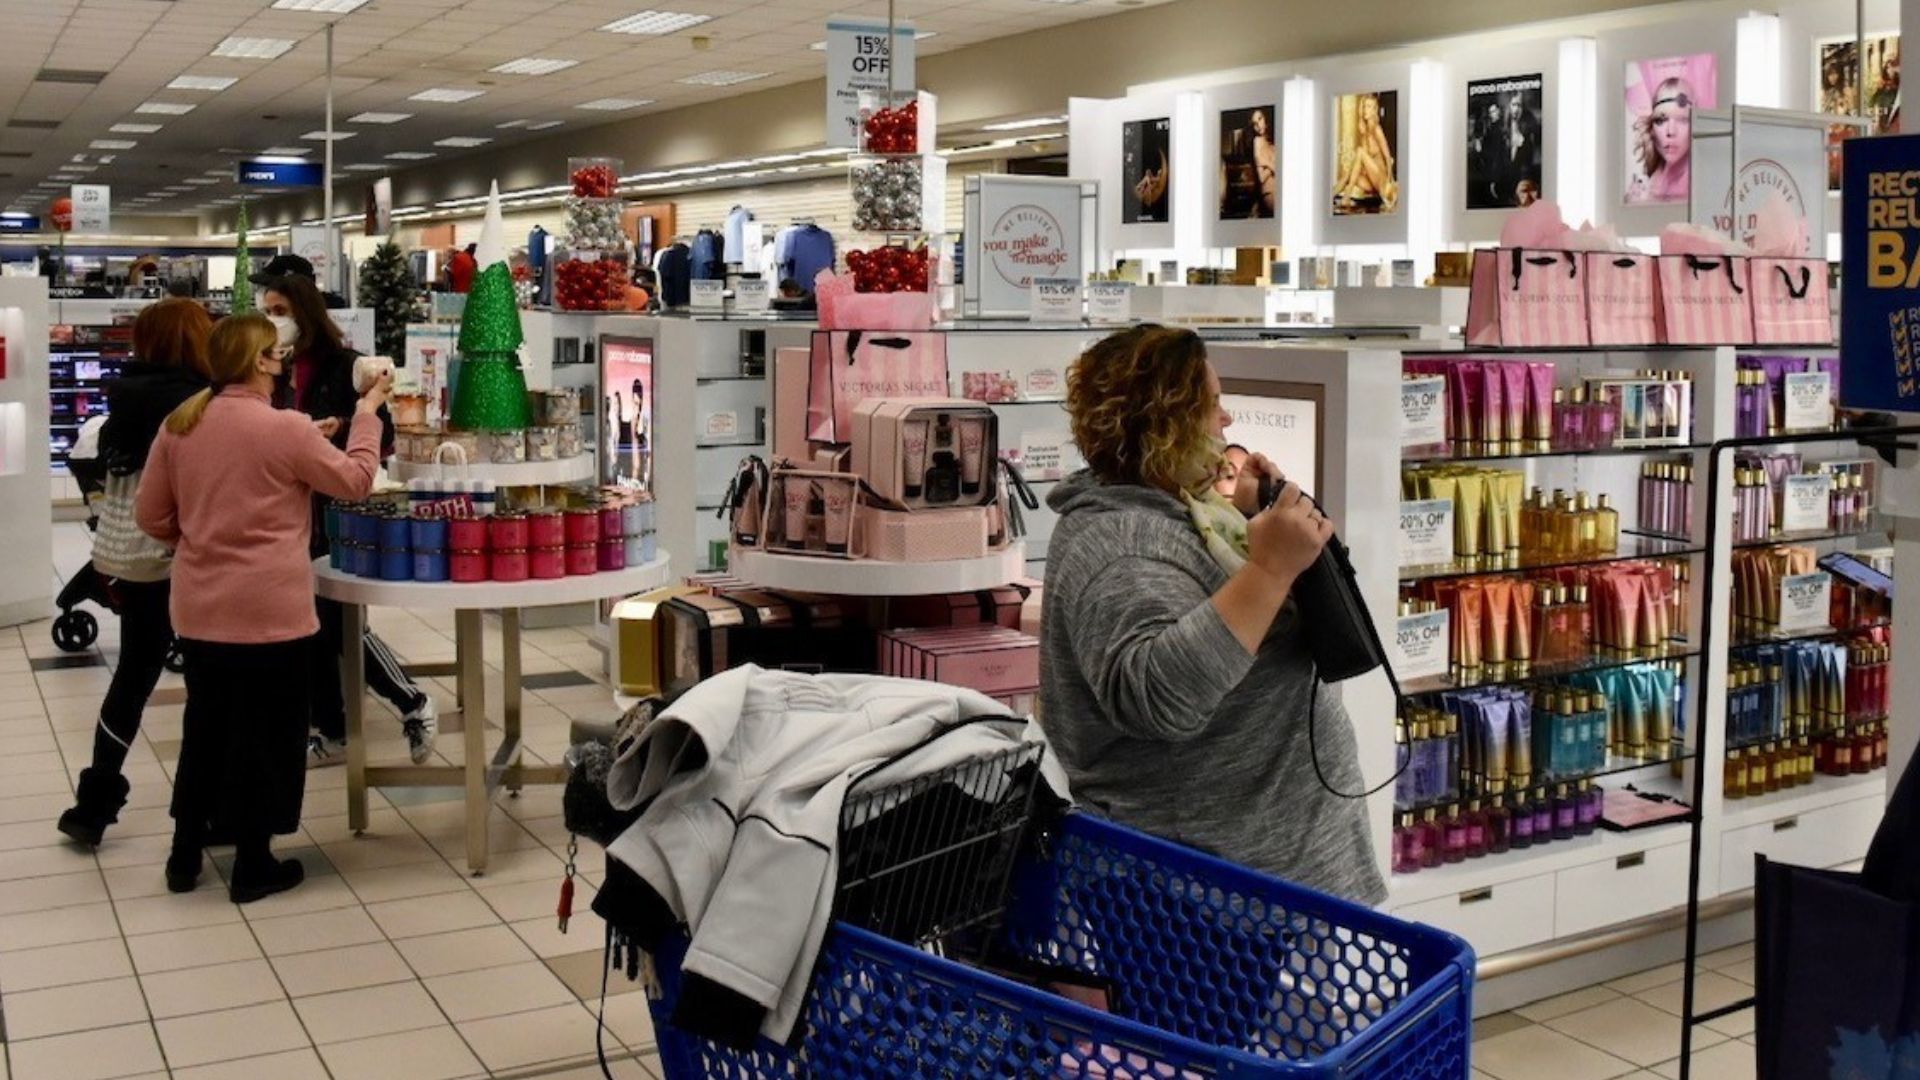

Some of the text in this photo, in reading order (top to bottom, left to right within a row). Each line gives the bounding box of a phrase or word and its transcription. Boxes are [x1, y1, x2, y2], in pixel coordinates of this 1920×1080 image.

[856, 36, 889, 55] 15%
[852, 56, 890, 73] OFF
[1470, 79, 1541, 96] paco rabanne
[984, 234, 1049, 254] you make
[1027, 249, 1068, 266] magic
[1039, 285, 1076, 295] 15% Off
[839, 381, 943, 393] VICTORIA'S SECRET
[1254, 411, 1297, 429] SECRET
[1399, 511, 1446, 529] 20% Off
[1422, 624, 1440, 640] Off
